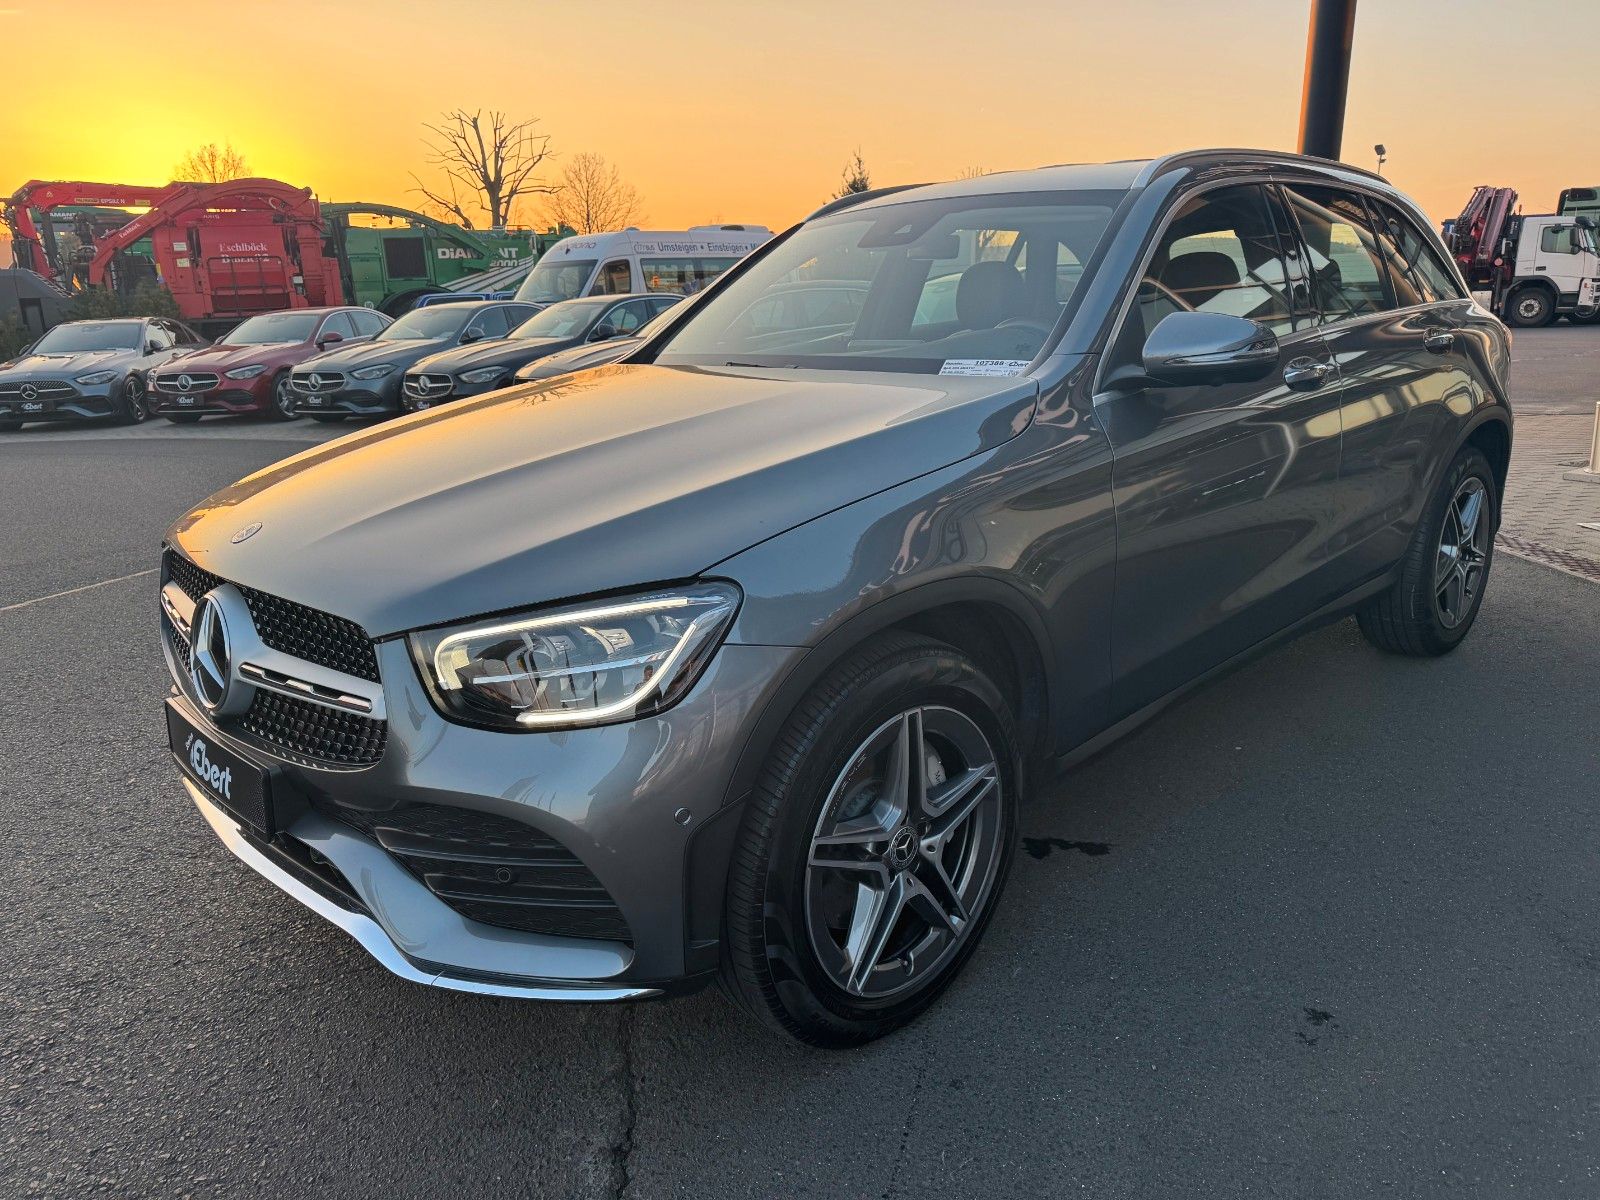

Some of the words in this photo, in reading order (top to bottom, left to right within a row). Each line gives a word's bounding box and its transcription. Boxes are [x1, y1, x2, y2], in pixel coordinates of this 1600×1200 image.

[220, 242, 268, 252] Eschlböck
[658, 242, 698, 253] Umsteigen
[708, 243, 744, 253] Einsteigen
[189, 738, 232, 800] Ebert
